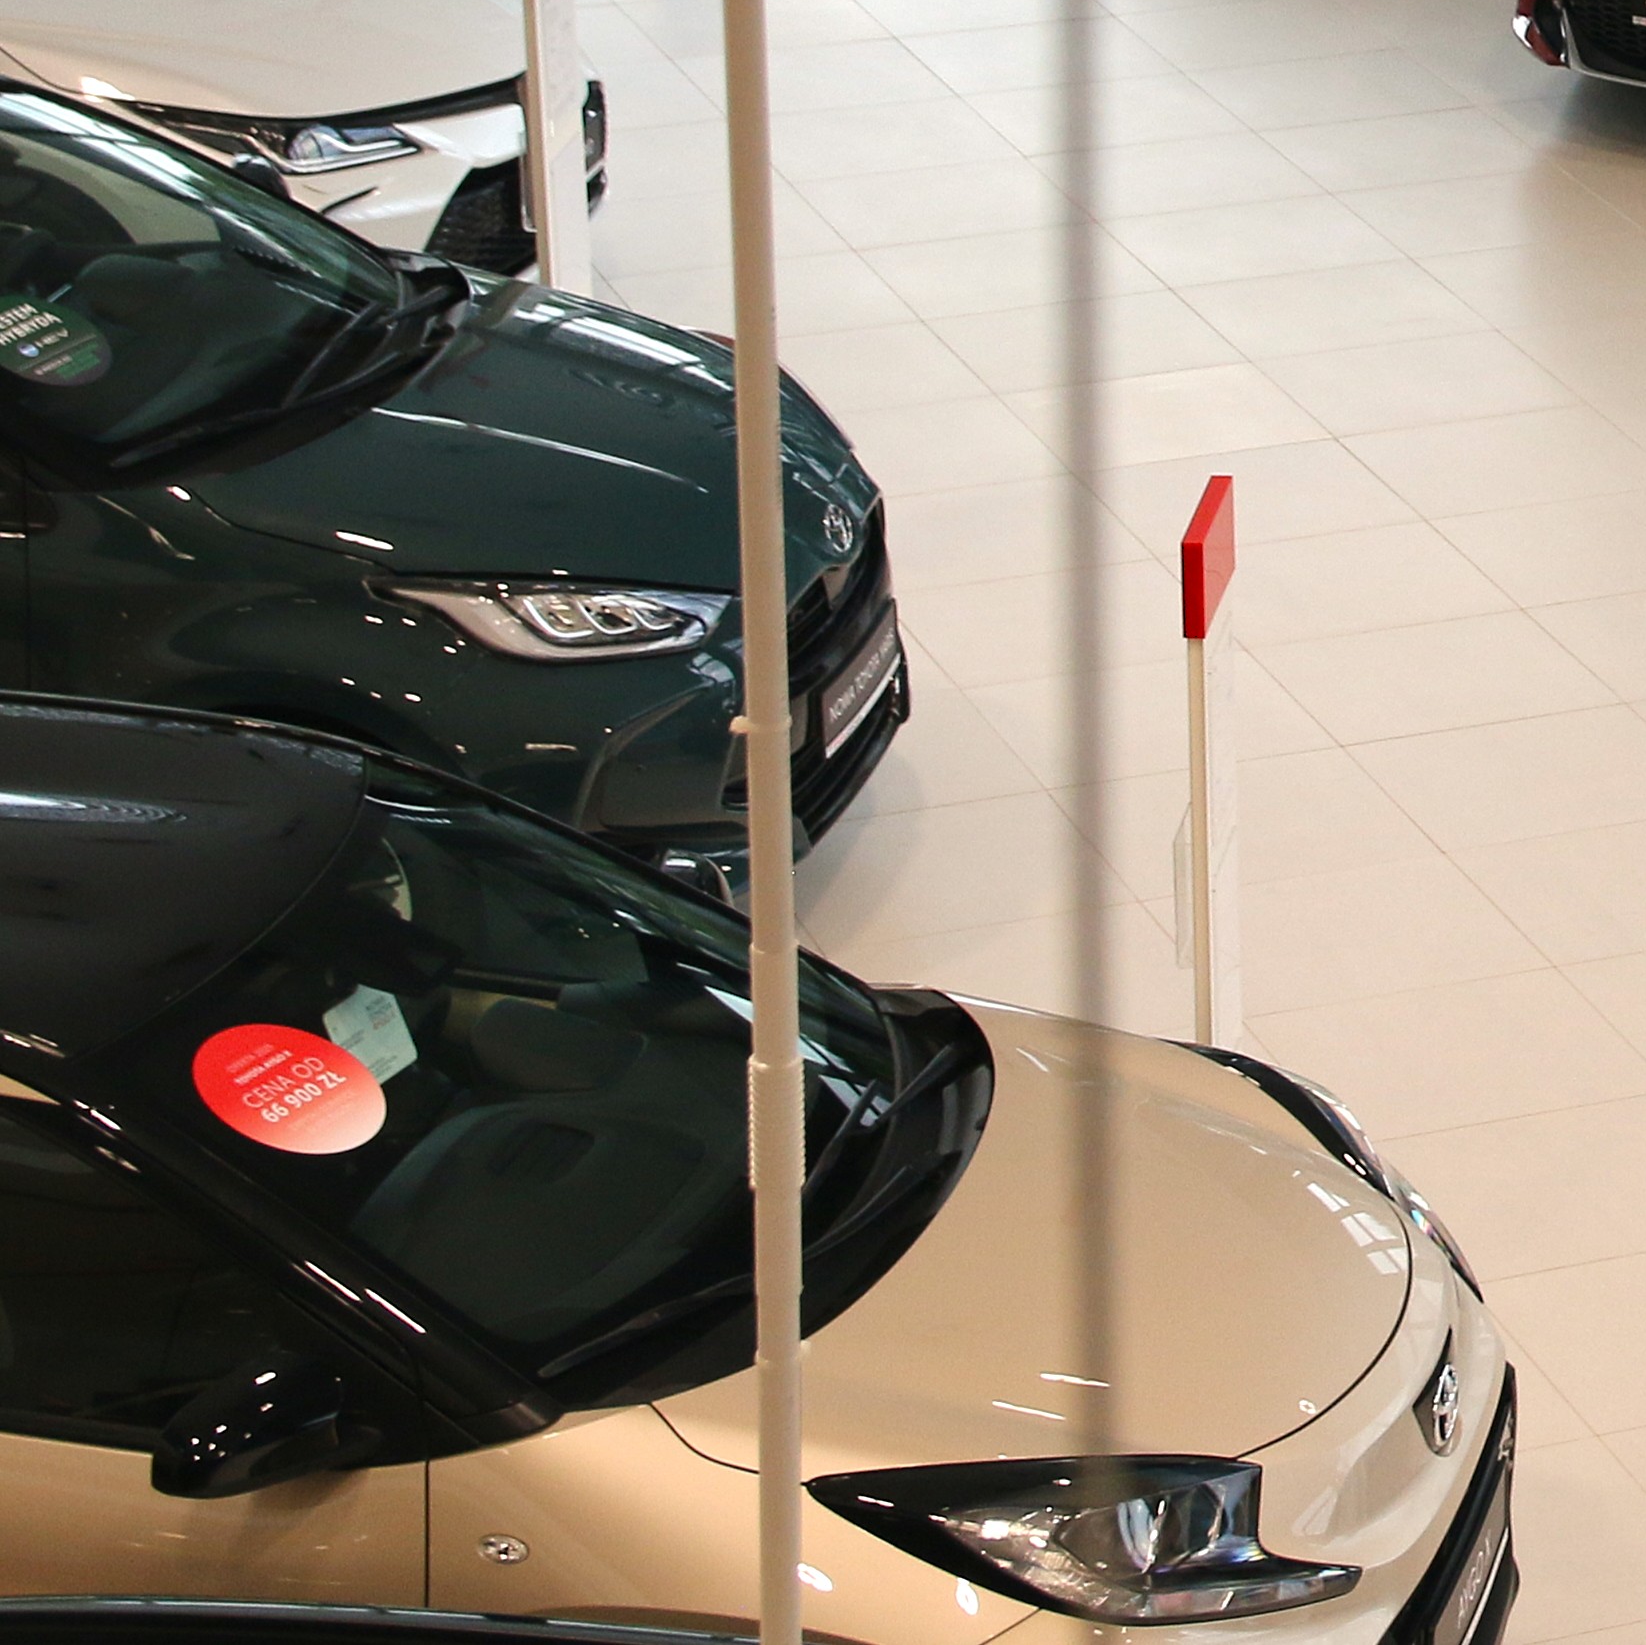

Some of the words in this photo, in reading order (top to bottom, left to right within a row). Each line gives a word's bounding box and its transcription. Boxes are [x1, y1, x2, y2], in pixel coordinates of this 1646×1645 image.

[0, 303, 39, 329] STEM
[242, 1074, 296, 1109] CENA
[292, 1056, 325, 1079] OD
[260, 1102, 290, 1123] 66
[283, 1081, 323, 1108] 900
[316, 1068, 348, 1089] ZŁ
